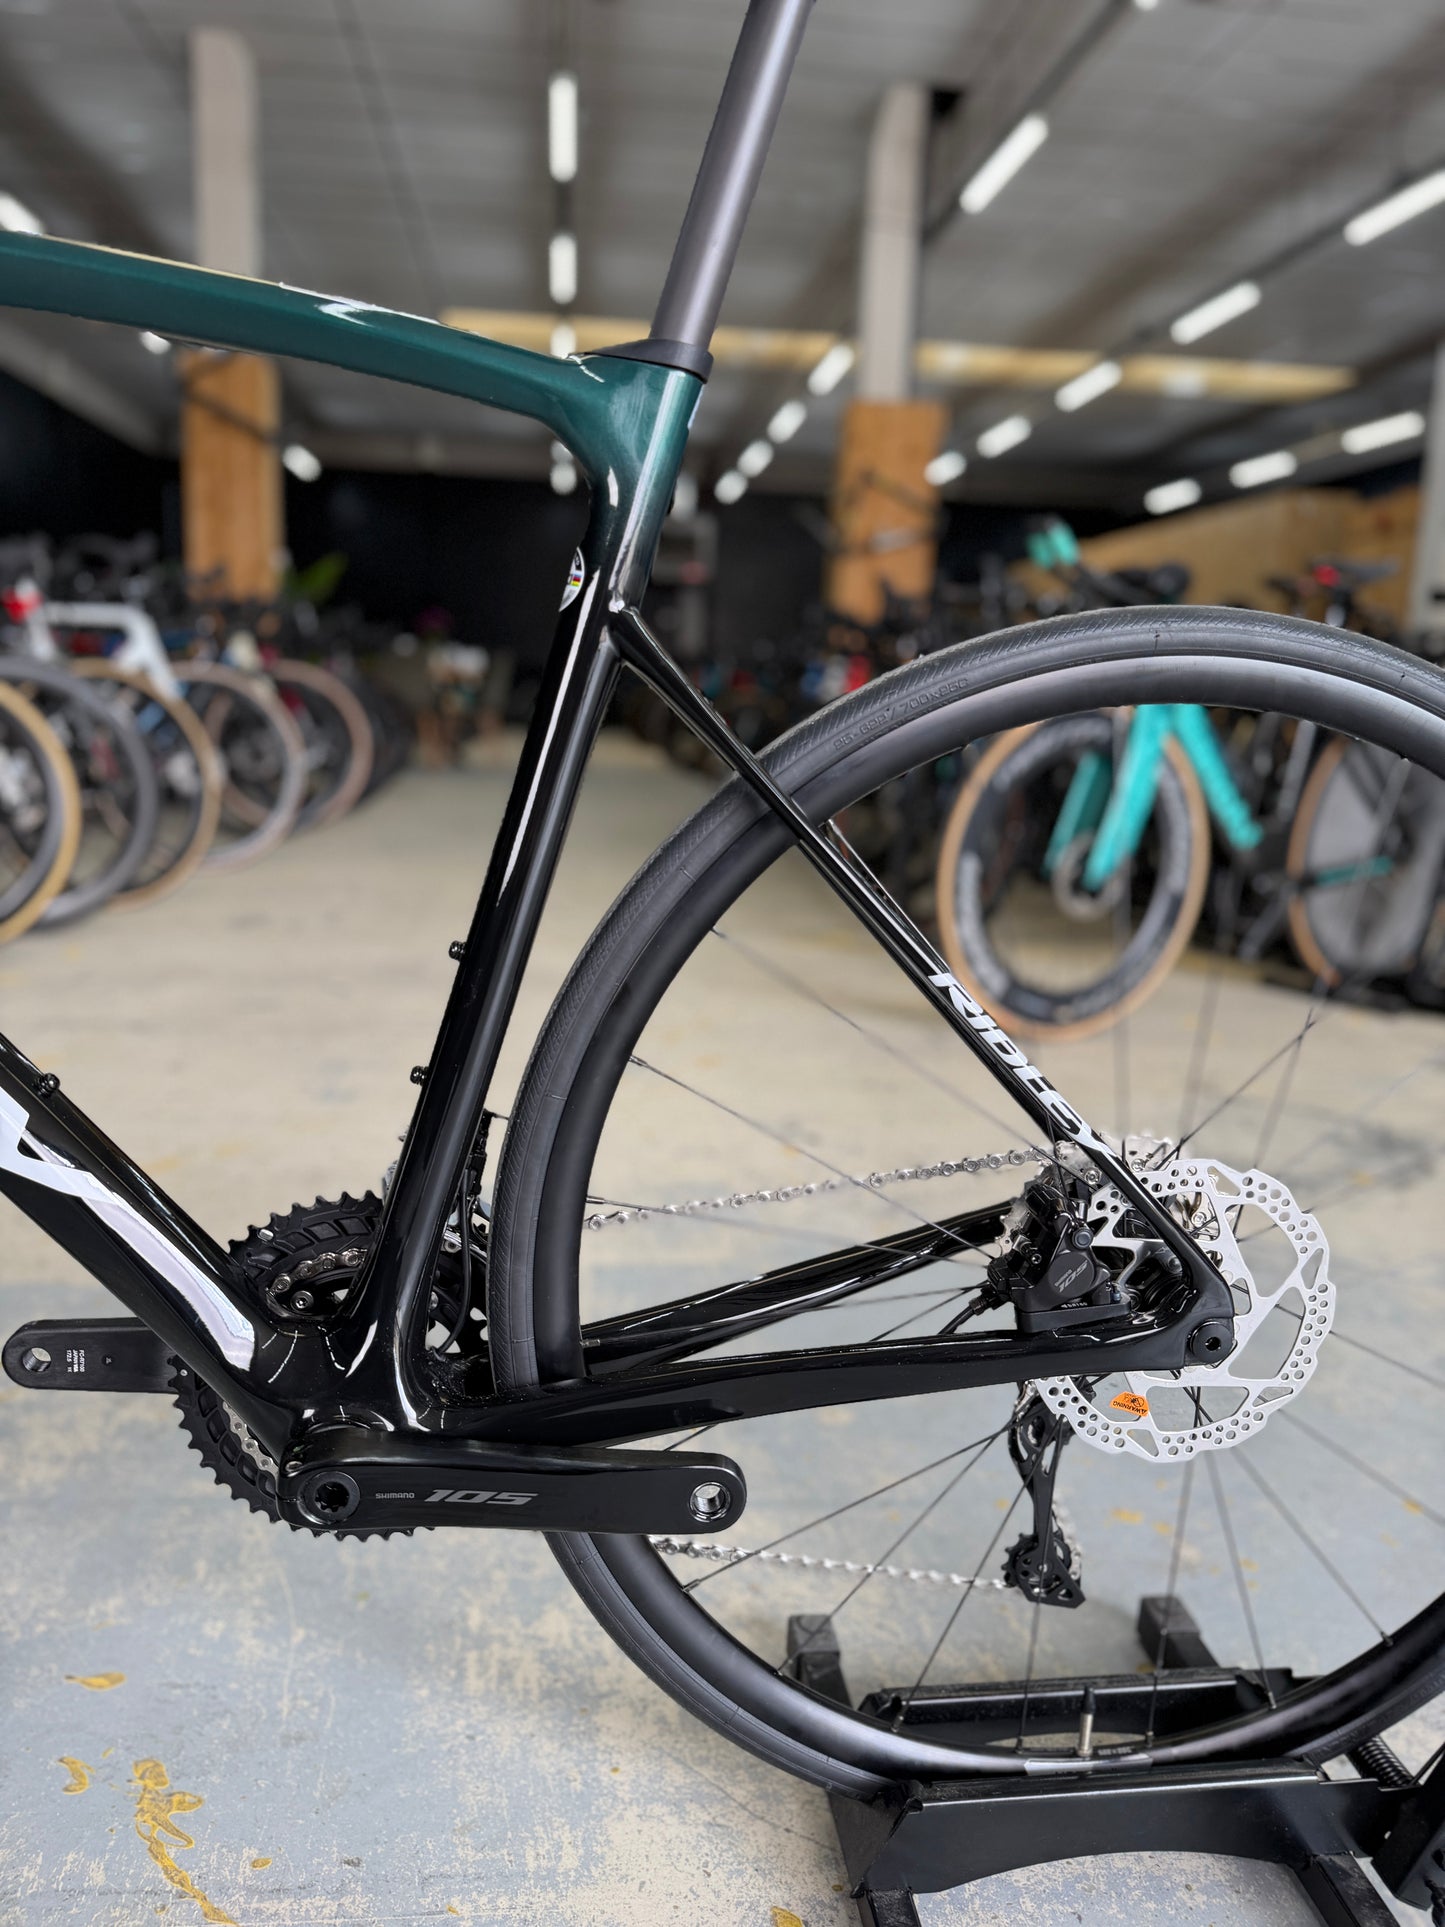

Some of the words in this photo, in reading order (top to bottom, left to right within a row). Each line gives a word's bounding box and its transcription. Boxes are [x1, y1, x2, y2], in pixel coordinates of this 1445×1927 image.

[928, 973, 1118, 1158] RIDLEY
[1059, 1260, 1088, 1293] 105
[424, 1489, 539, 1505] 105
